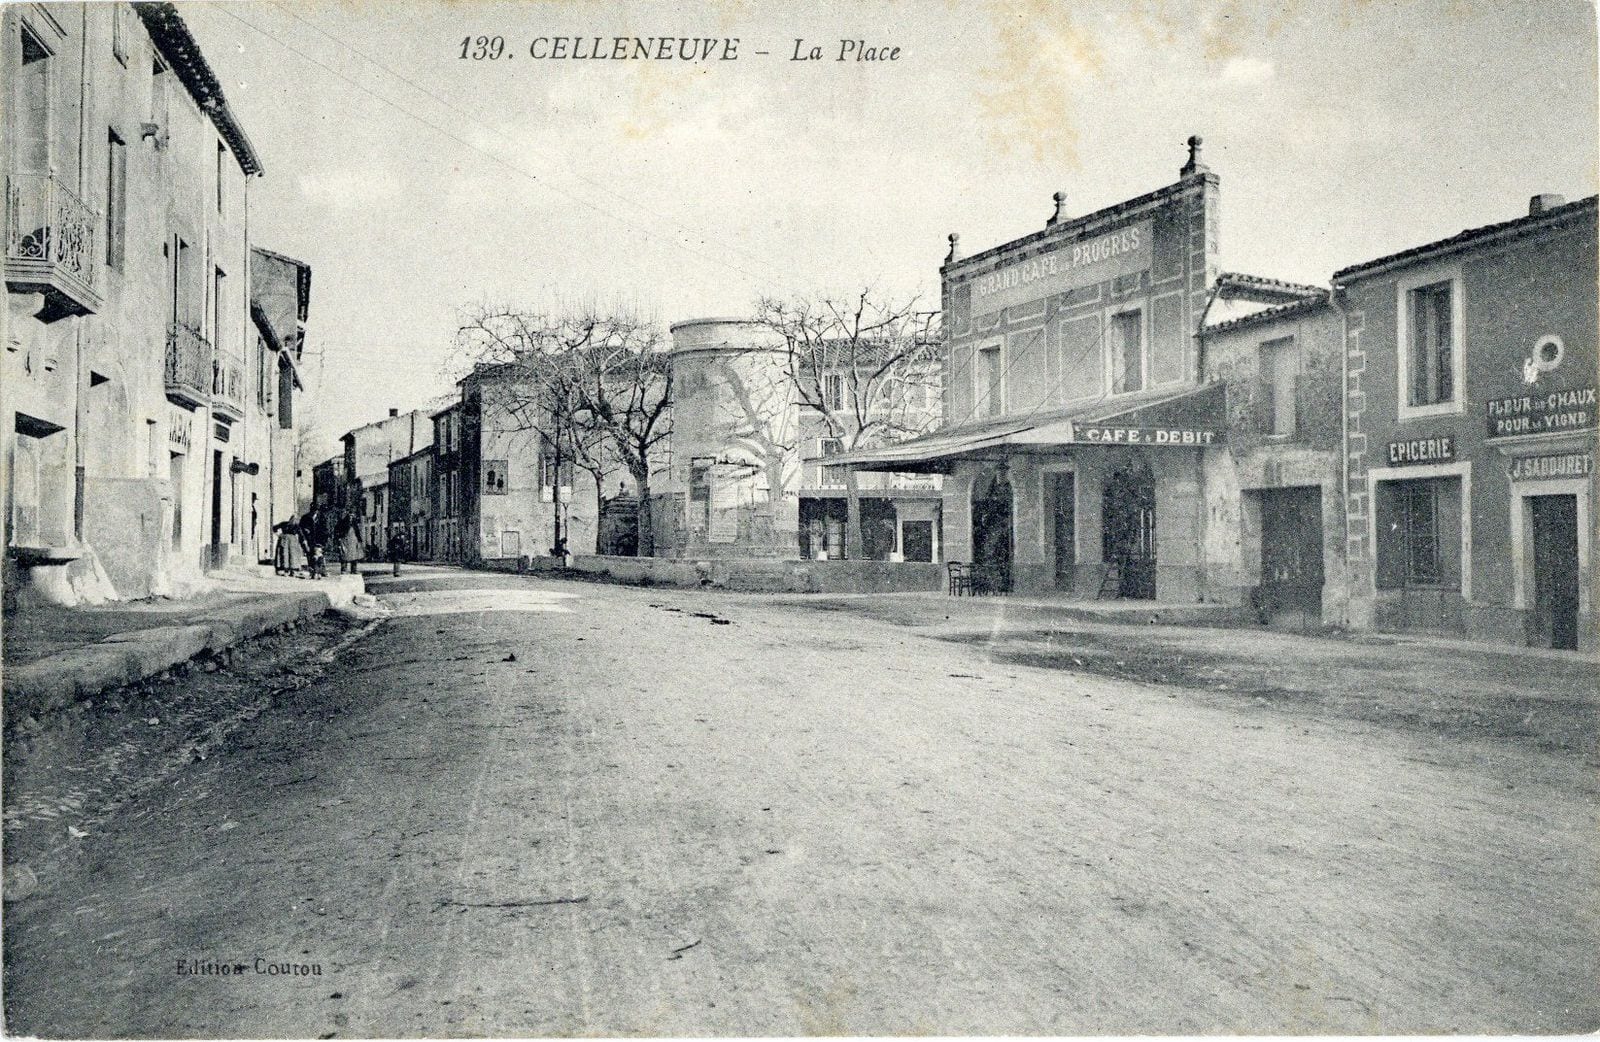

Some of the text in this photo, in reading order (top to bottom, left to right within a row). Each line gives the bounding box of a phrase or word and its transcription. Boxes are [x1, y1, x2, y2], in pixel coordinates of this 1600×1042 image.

[980, 267, 1019, 297] GRAND
[1488, 396, 1531, 416] FLEUR
[1548, 388, 1596, 409] CHAUX
[1497, 416, 1529, 432] POUR
[1544, 411, 1587, 428] VIGNE
[1155, 429, 1215, 444] DEBIT
[1389, 438, 1451, 462] EPICERIE
